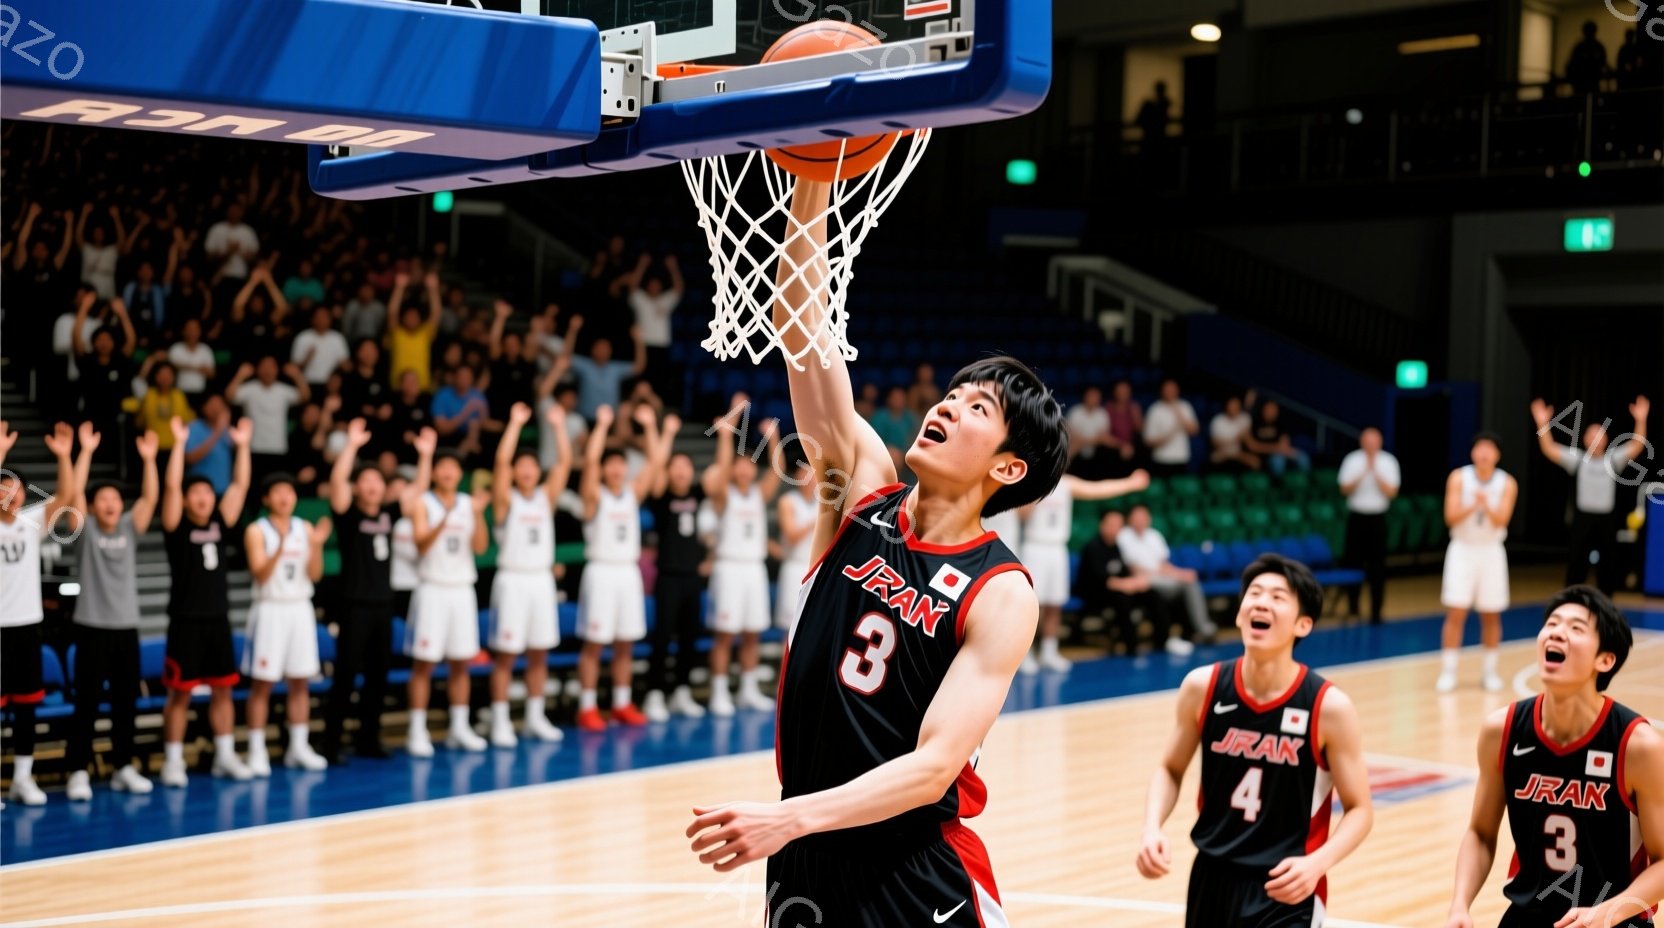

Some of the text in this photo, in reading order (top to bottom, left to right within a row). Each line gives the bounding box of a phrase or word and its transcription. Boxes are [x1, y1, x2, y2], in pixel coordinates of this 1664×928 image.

[840, 613, 897, 694] 3
[1231, 768, 1262, 822] 4
[1544, 814, 1577, 872] 3
